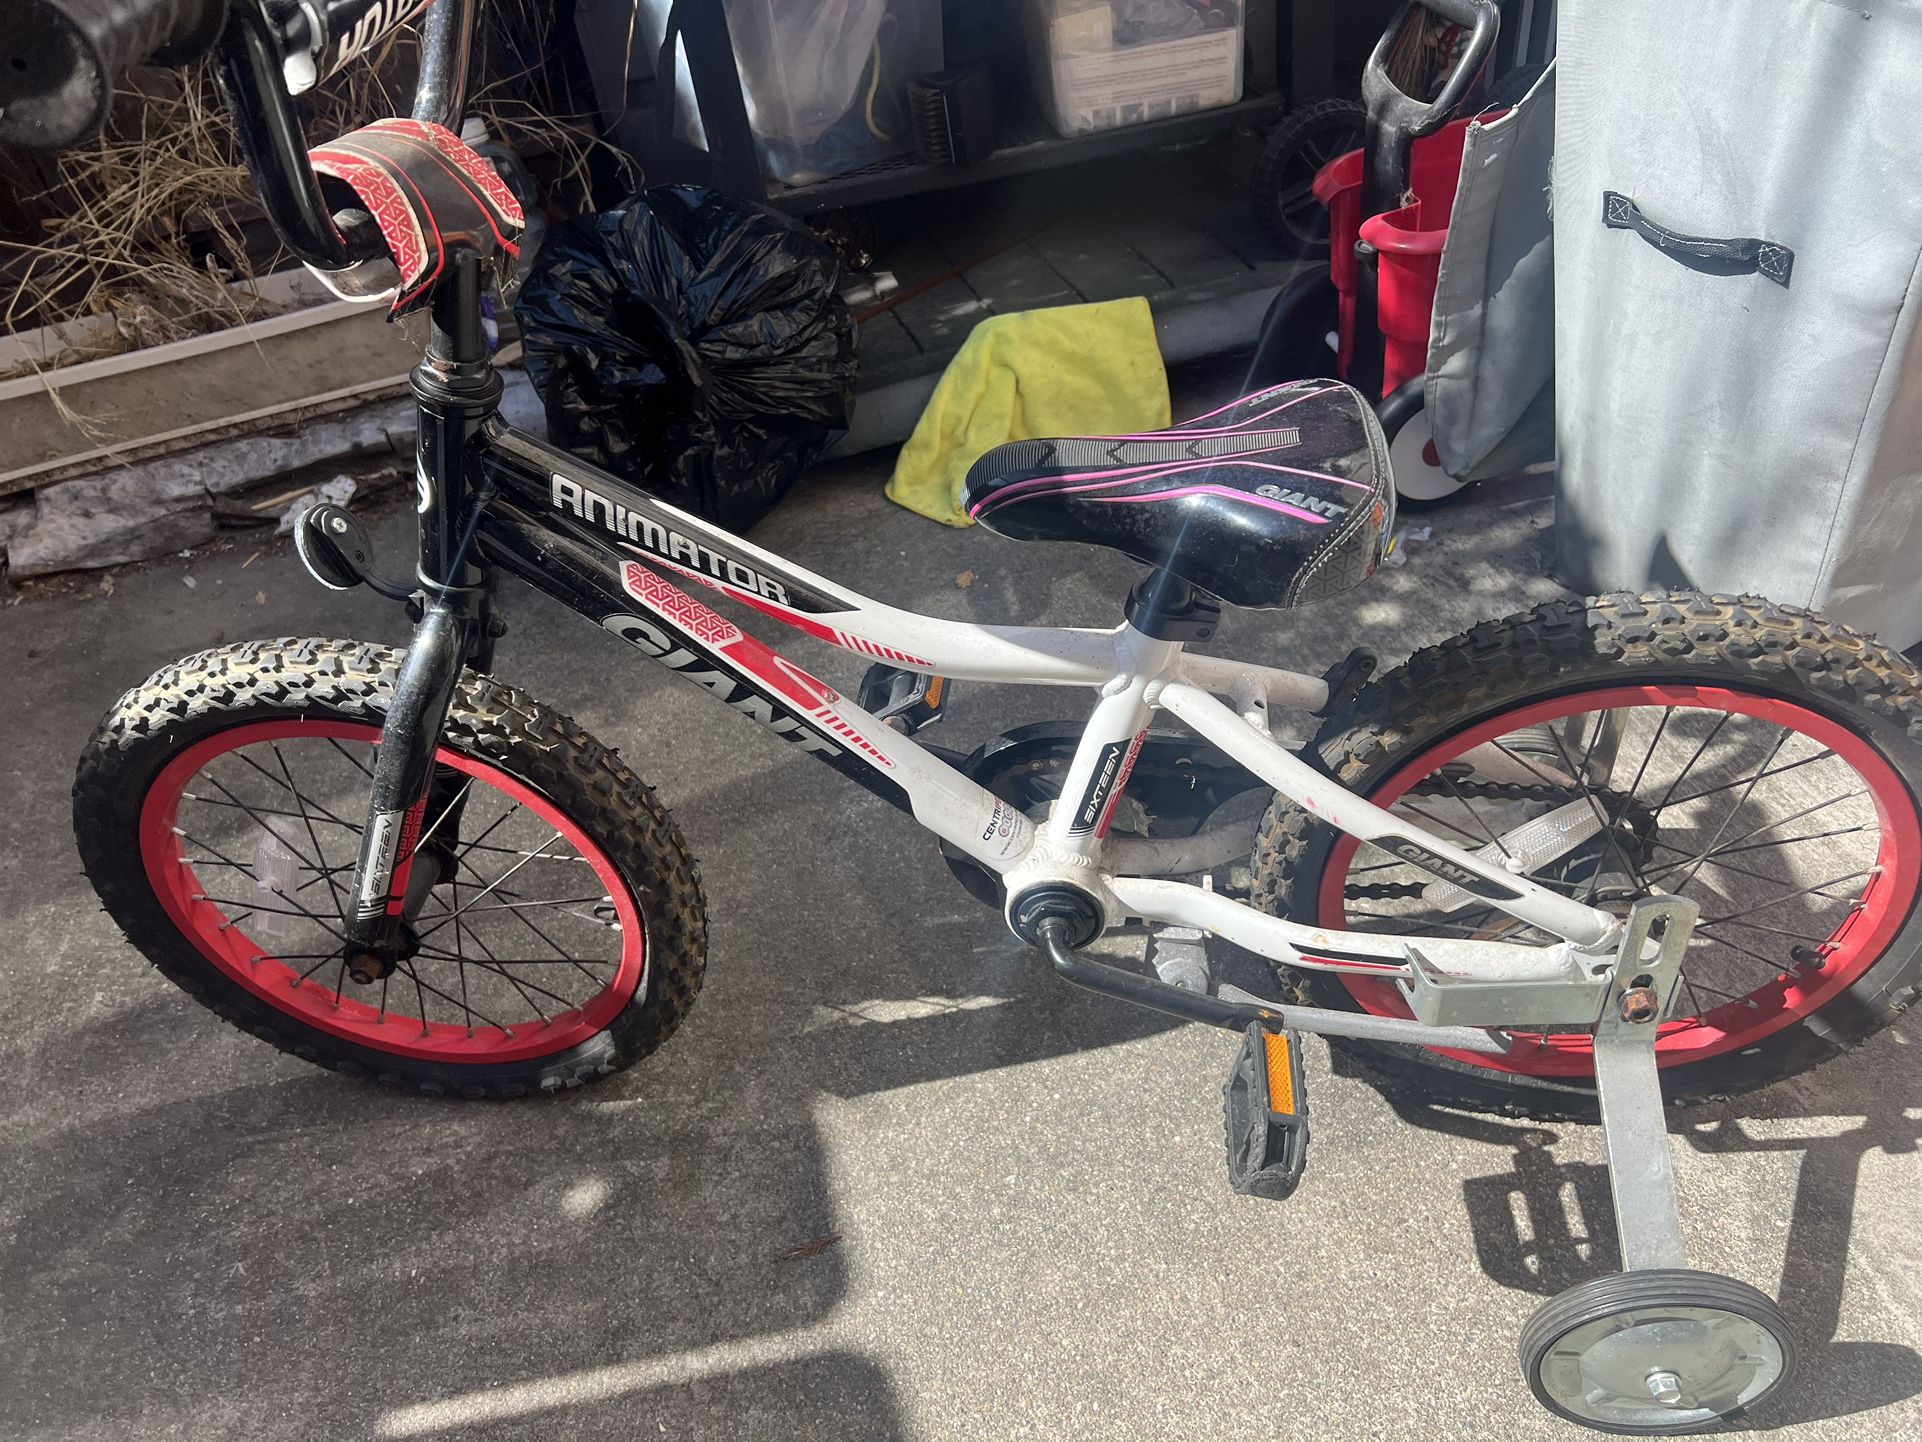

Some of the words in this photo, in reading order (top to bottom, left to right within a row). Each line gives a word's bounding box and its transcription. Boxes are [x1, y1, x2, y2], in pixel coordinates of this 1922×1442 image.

[551, 473, 790, 606] ANIMATOR
[1255, 484, 1349, 518] GIANT
[600, 613, 844, 758] GIANT
[1083, 746, 1120, 824] SIXTEEN
[1396, 844, 1481, 885] GIANT
